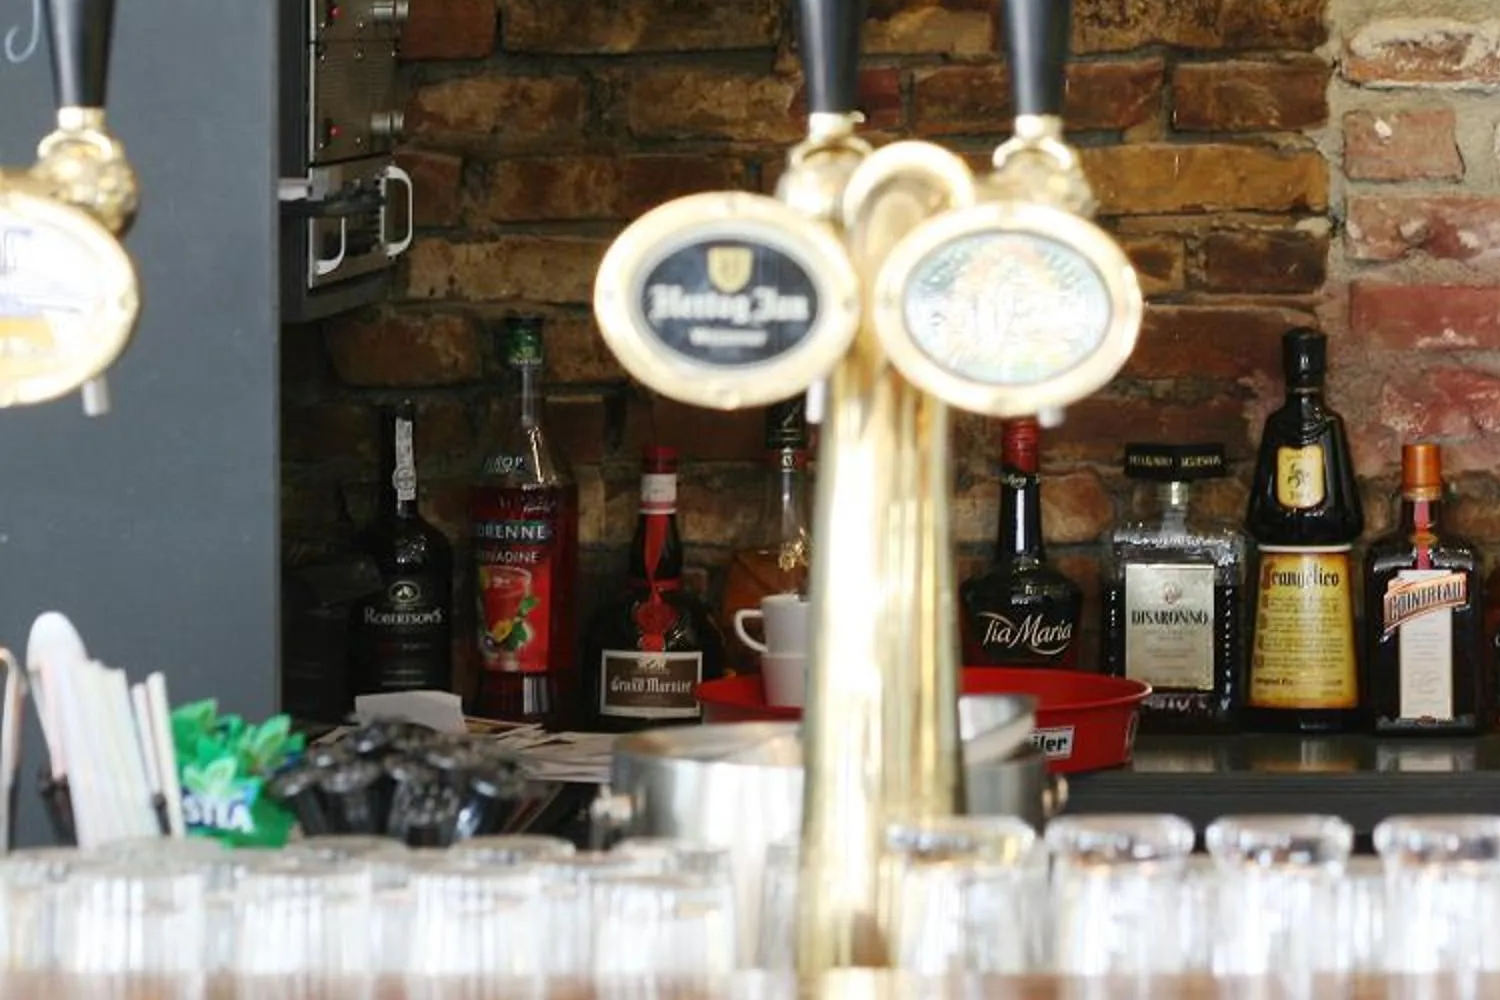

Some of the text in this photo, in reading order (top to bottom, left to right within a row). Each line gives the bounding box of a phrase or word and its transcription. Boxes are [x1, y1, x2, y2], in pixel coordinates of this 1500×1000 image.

[977, 610, 1073, 652] Tia Maria
[1131, 610, 1208, 627] DISARONNO
